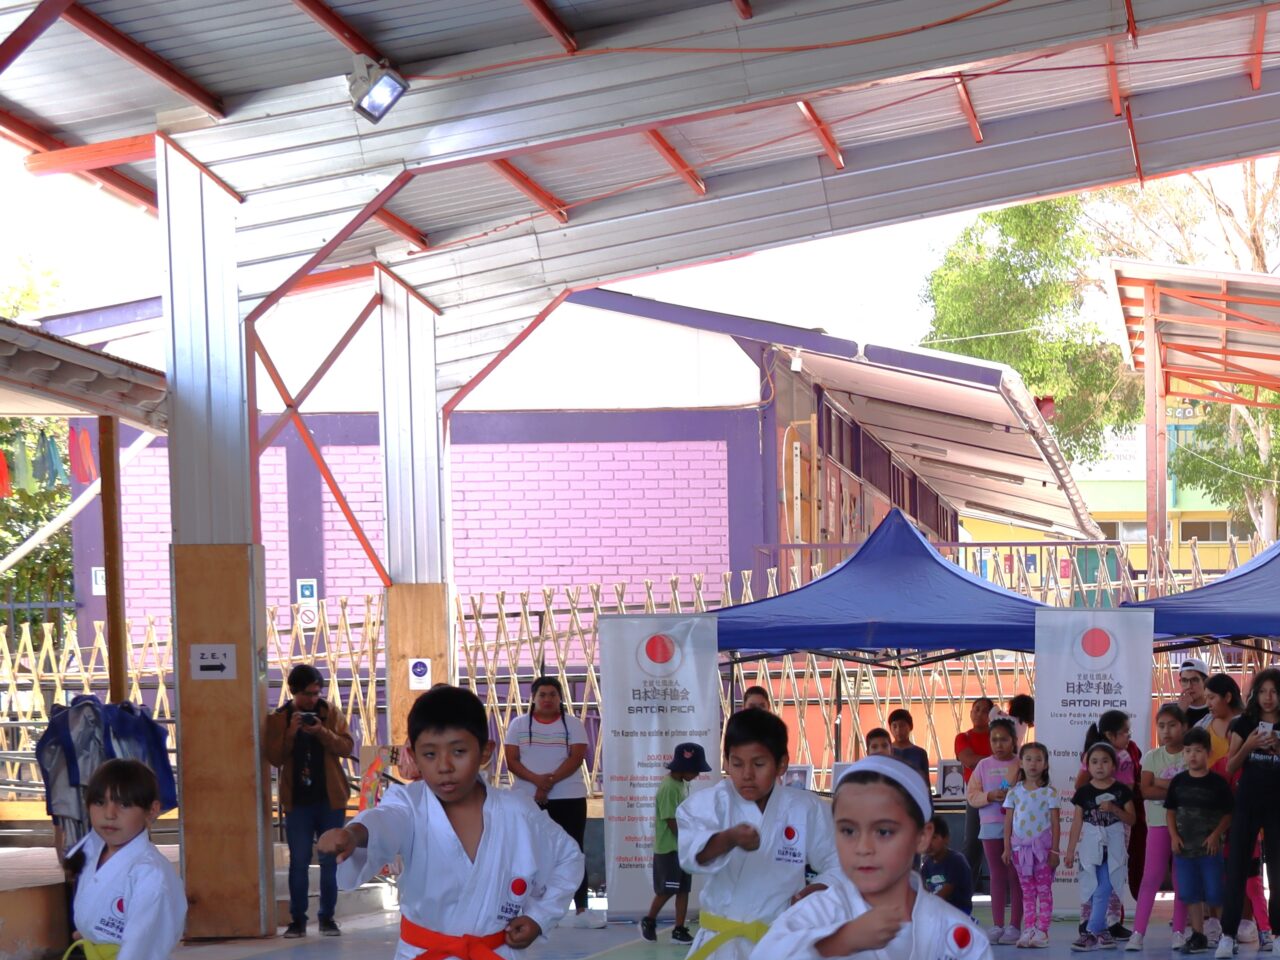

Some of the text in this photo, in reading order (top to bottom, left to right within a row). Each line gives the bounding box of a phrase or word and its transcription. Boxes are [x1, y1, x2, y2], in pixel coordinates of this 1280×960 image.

[1061, 699, 1127, 707] SATORI PICA
[628, 705, 695, 714] SATORI PICA
